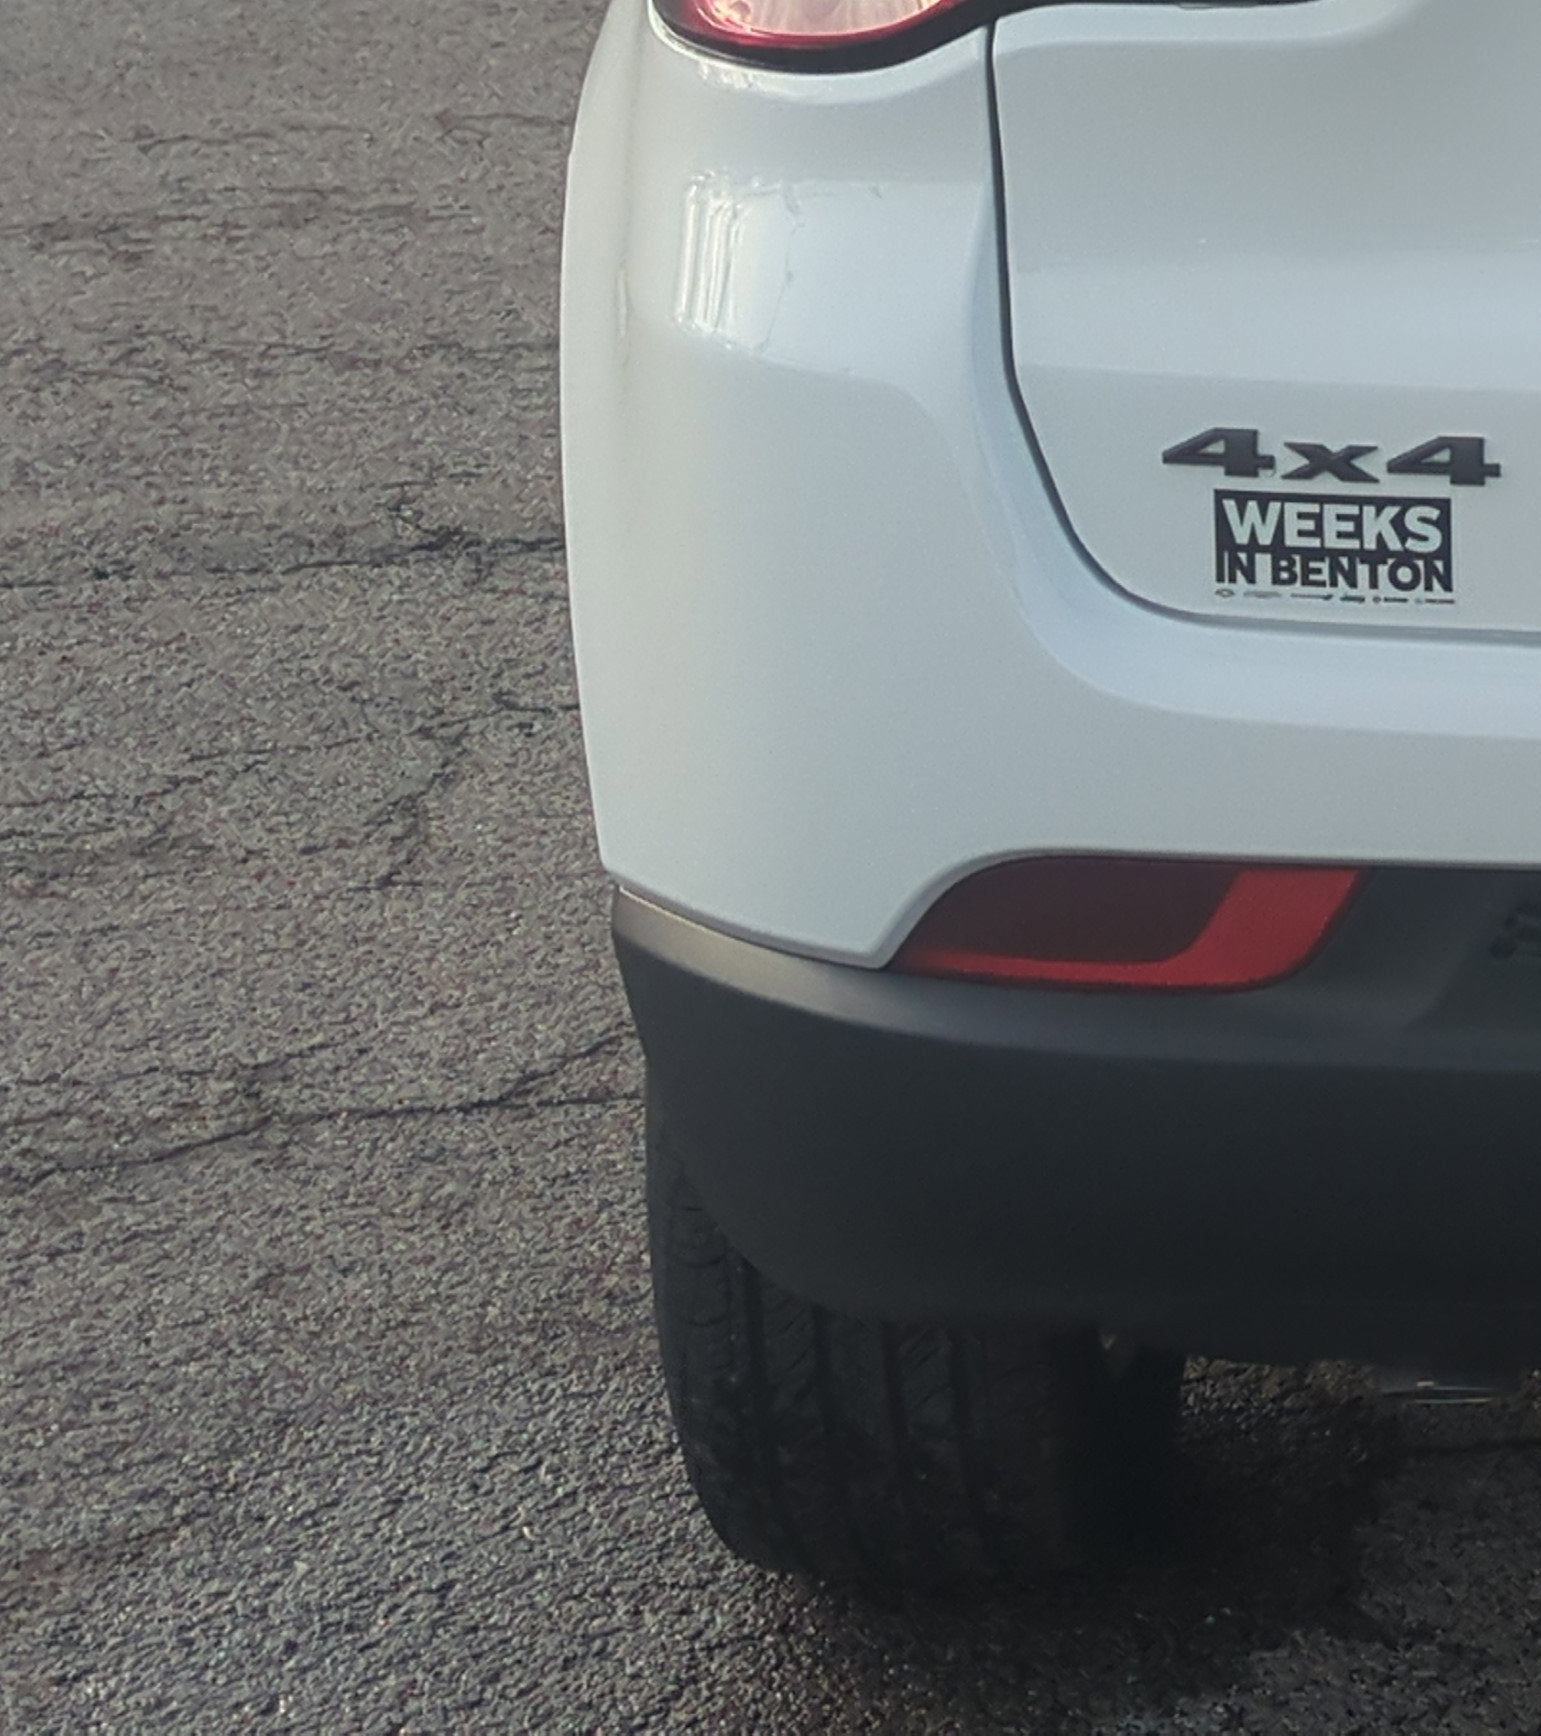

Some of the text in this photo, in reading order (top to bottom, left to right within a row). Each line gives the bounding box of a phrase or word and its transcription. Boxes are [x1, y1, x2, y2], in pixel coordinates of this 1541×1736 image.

[1162, 427, 1502, 487] 4x4
[1221, 498, 1443, 554] WEEKS
[1214, 551, 1454, 593] IN BENTON
